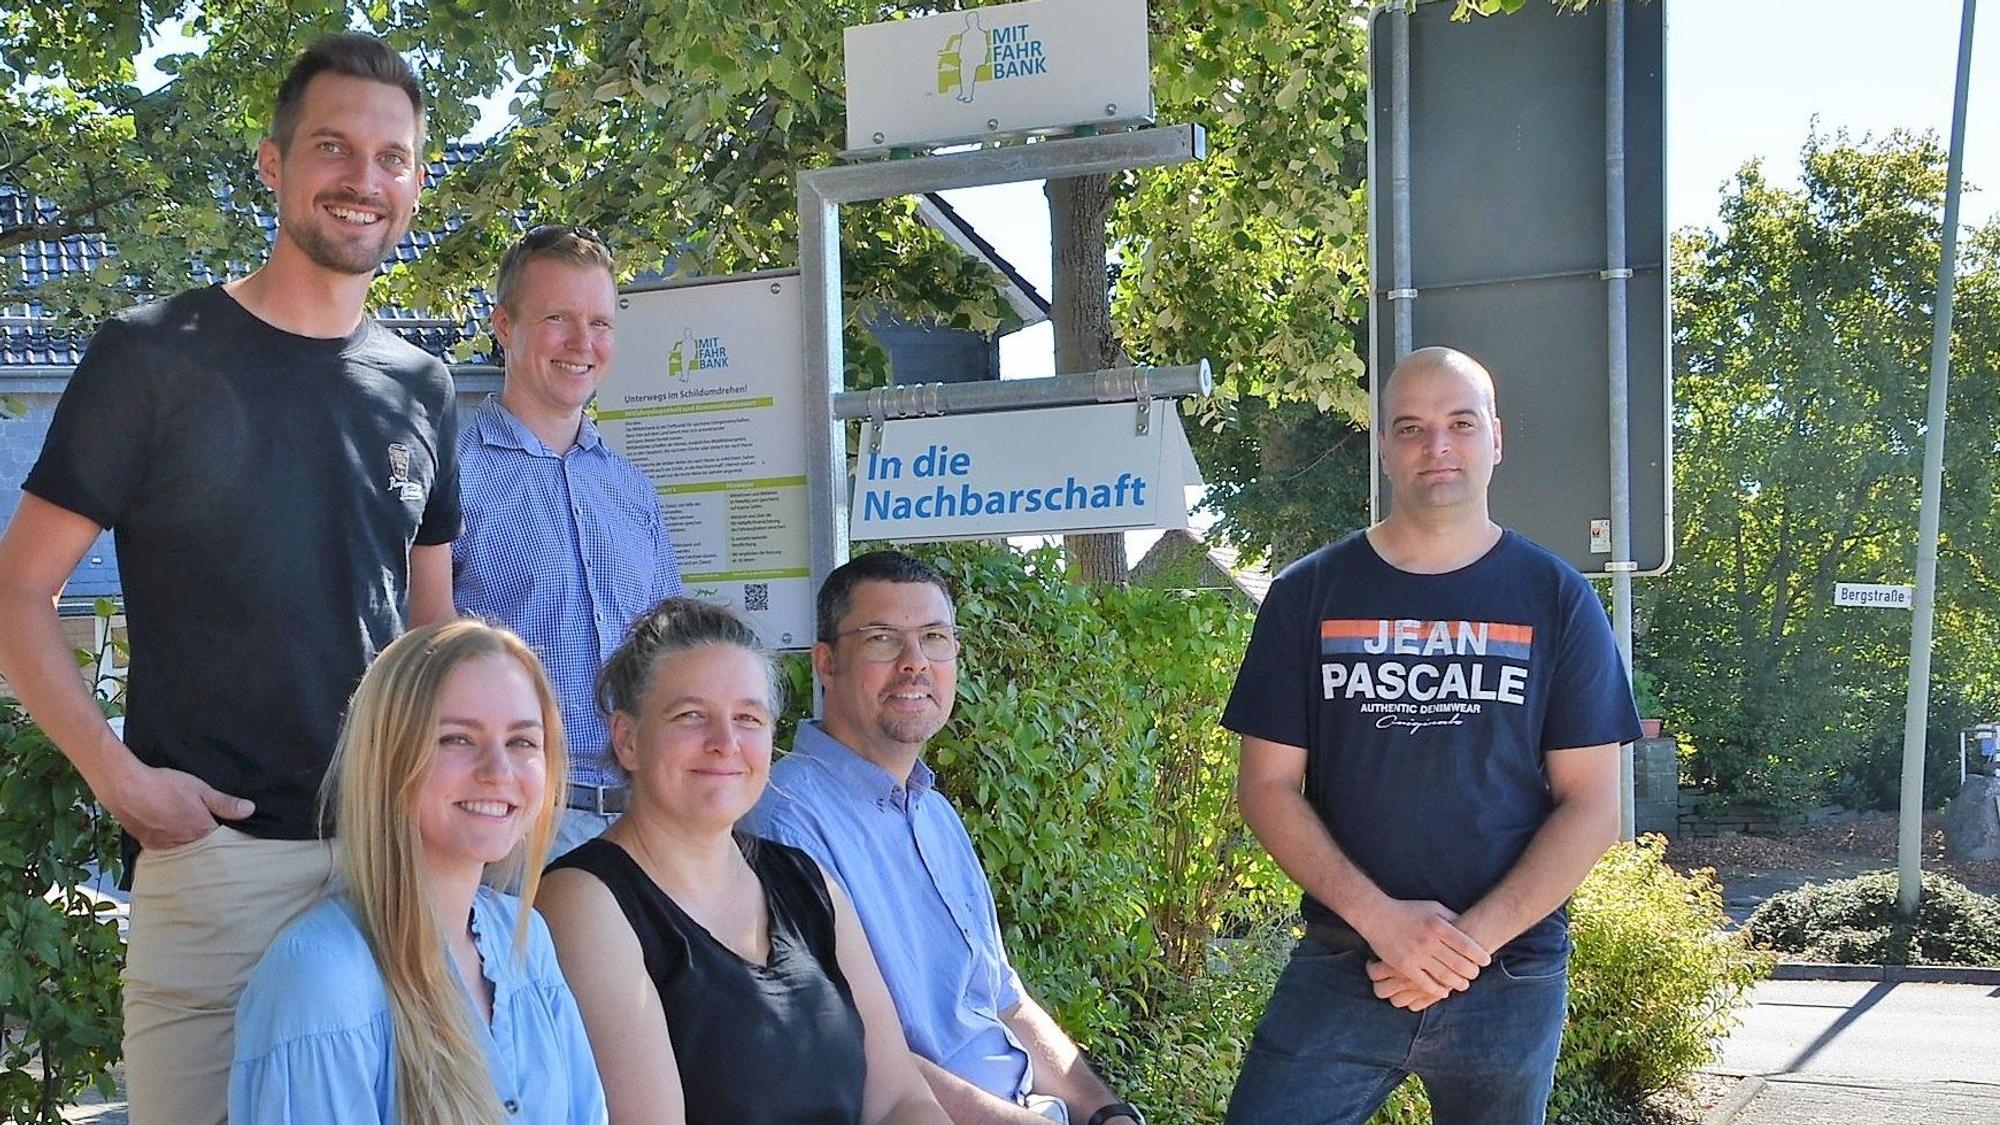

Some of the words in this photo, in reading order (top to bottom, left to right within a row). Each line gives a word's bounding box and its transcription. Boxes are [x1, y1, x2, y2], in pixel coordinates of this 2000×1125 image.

[992, 24, 1029, 45] MIT
[992, 40, 1042, 62] FAHR
[993, 56, 1047, 80] BANK
[698, 337, 719, 349] MIT
[699, 347, 726, 360] FAHR
[699, 357, 729, 370] BANK
[624, 392, 667, 404] Unterwegs
[668, 390, 679, 399] im
[680, 384, 748, 400] Schildumdrehen!
[868, 451, 902, 481] In
[912, 445, 970, 478] die
[864, 473, 1146, 521] Nachbarschaft
[1841, 587, 1905, 604] Bergstraße
[1363, 619, 1488, 656] JEAN
[1321, 662, 1529, 705] PASCALE
[1360, 703, 1418, 714] AUTHENTIC
[1420, 702, 1482, 714] DENIMWEAR
